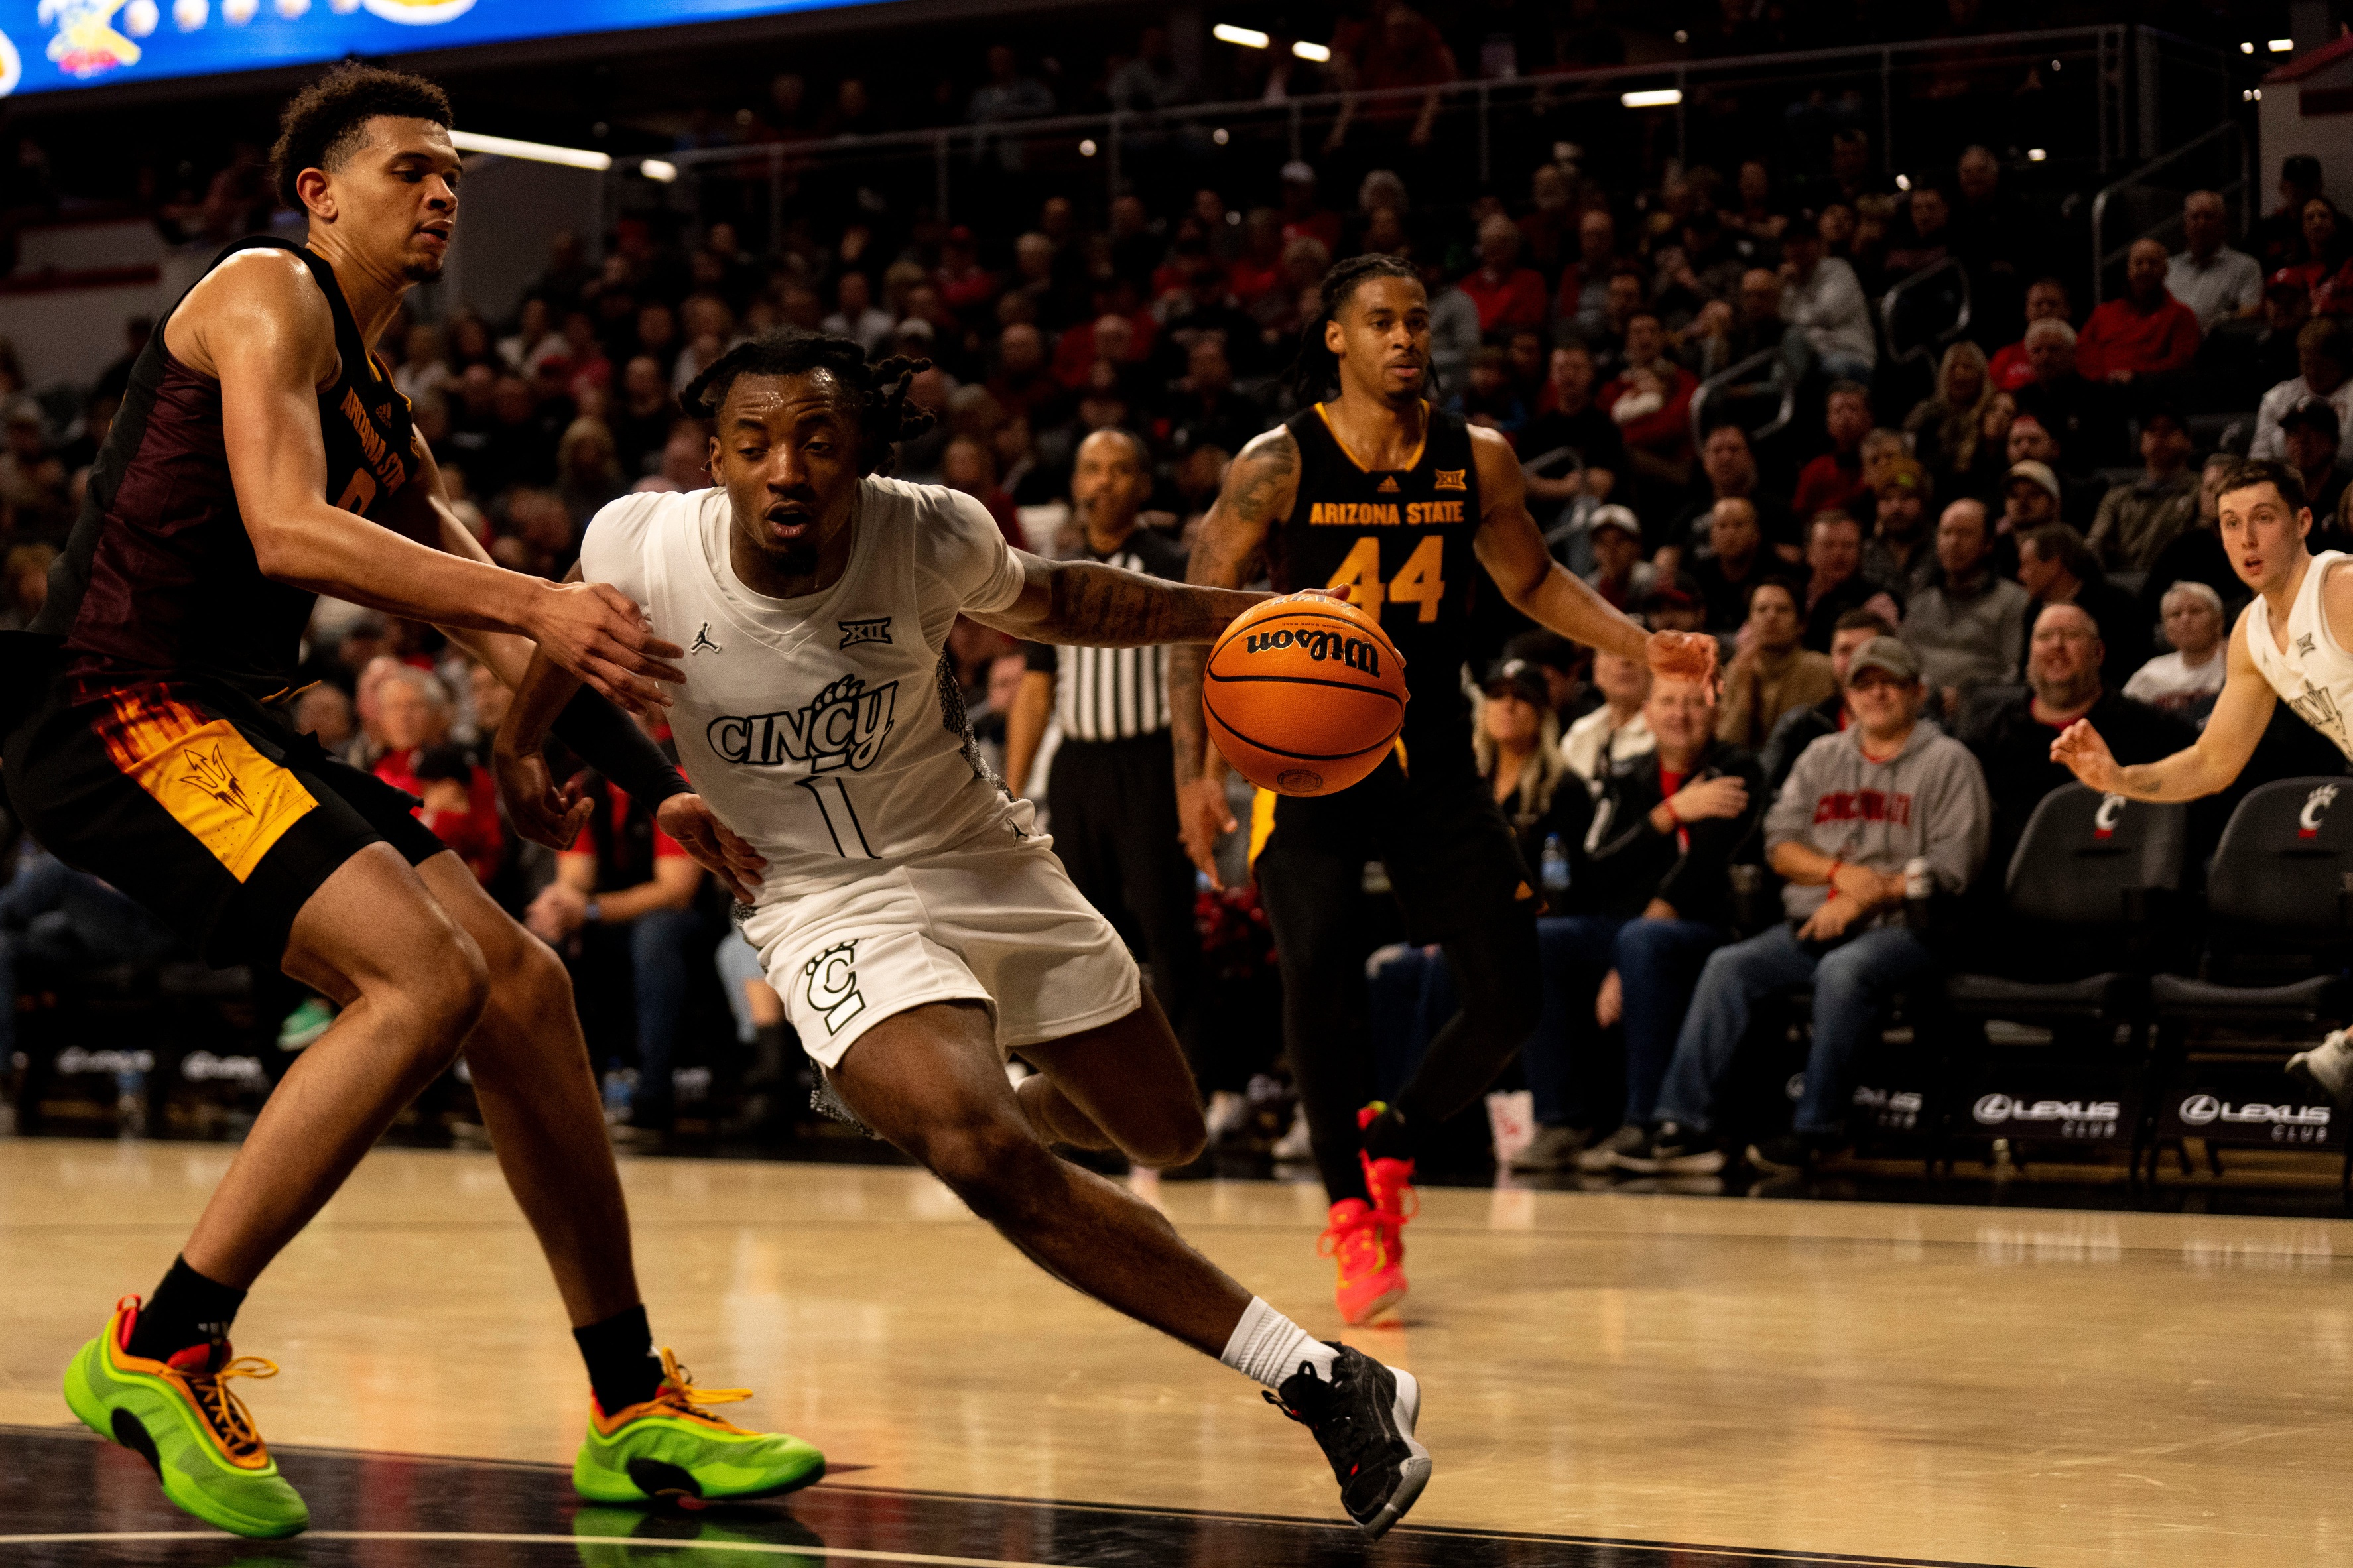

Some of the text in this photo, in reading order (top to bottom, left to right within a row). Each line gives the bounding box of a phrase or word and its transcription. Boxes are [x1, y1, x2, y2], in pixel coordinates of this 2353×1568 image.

[1309, 500, 1465, 526] ARIZONA STATE
[1325, 534, 1446, 625] 44
[1246, 629, 1381, 679] Wilson
[2013, 1100, 2120, 1121] LEXUS
[2220, 1101, 2332, 1126] LEXUS
[2271, 1124, 2328, 1143] CLUB
